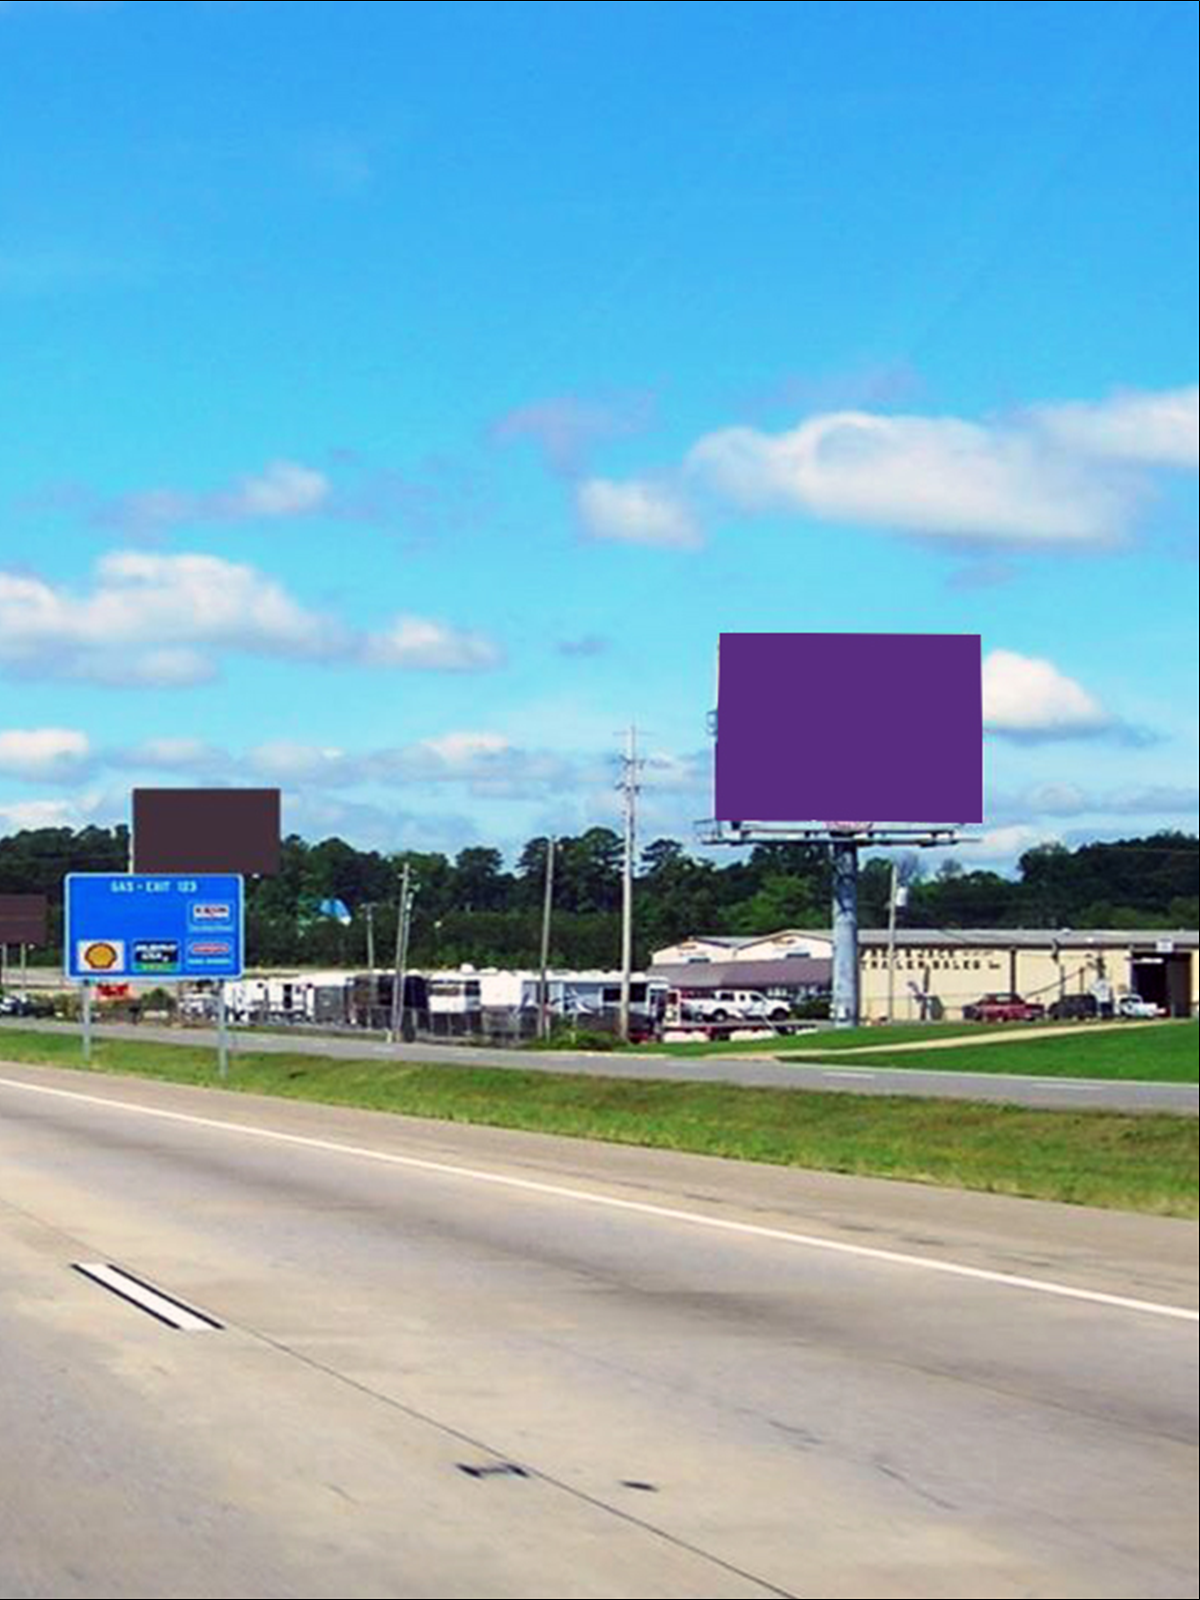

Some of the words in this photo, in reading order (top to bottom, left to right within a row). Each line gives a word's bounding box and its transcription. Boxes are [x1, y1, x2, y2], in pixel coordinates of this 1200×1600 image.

[110, 880, 134, 892] GAS
[145, 880, 170, 892] EXIT
[176, 880, 197, 892] 123
[860, 960, 925, 970] TRALER
